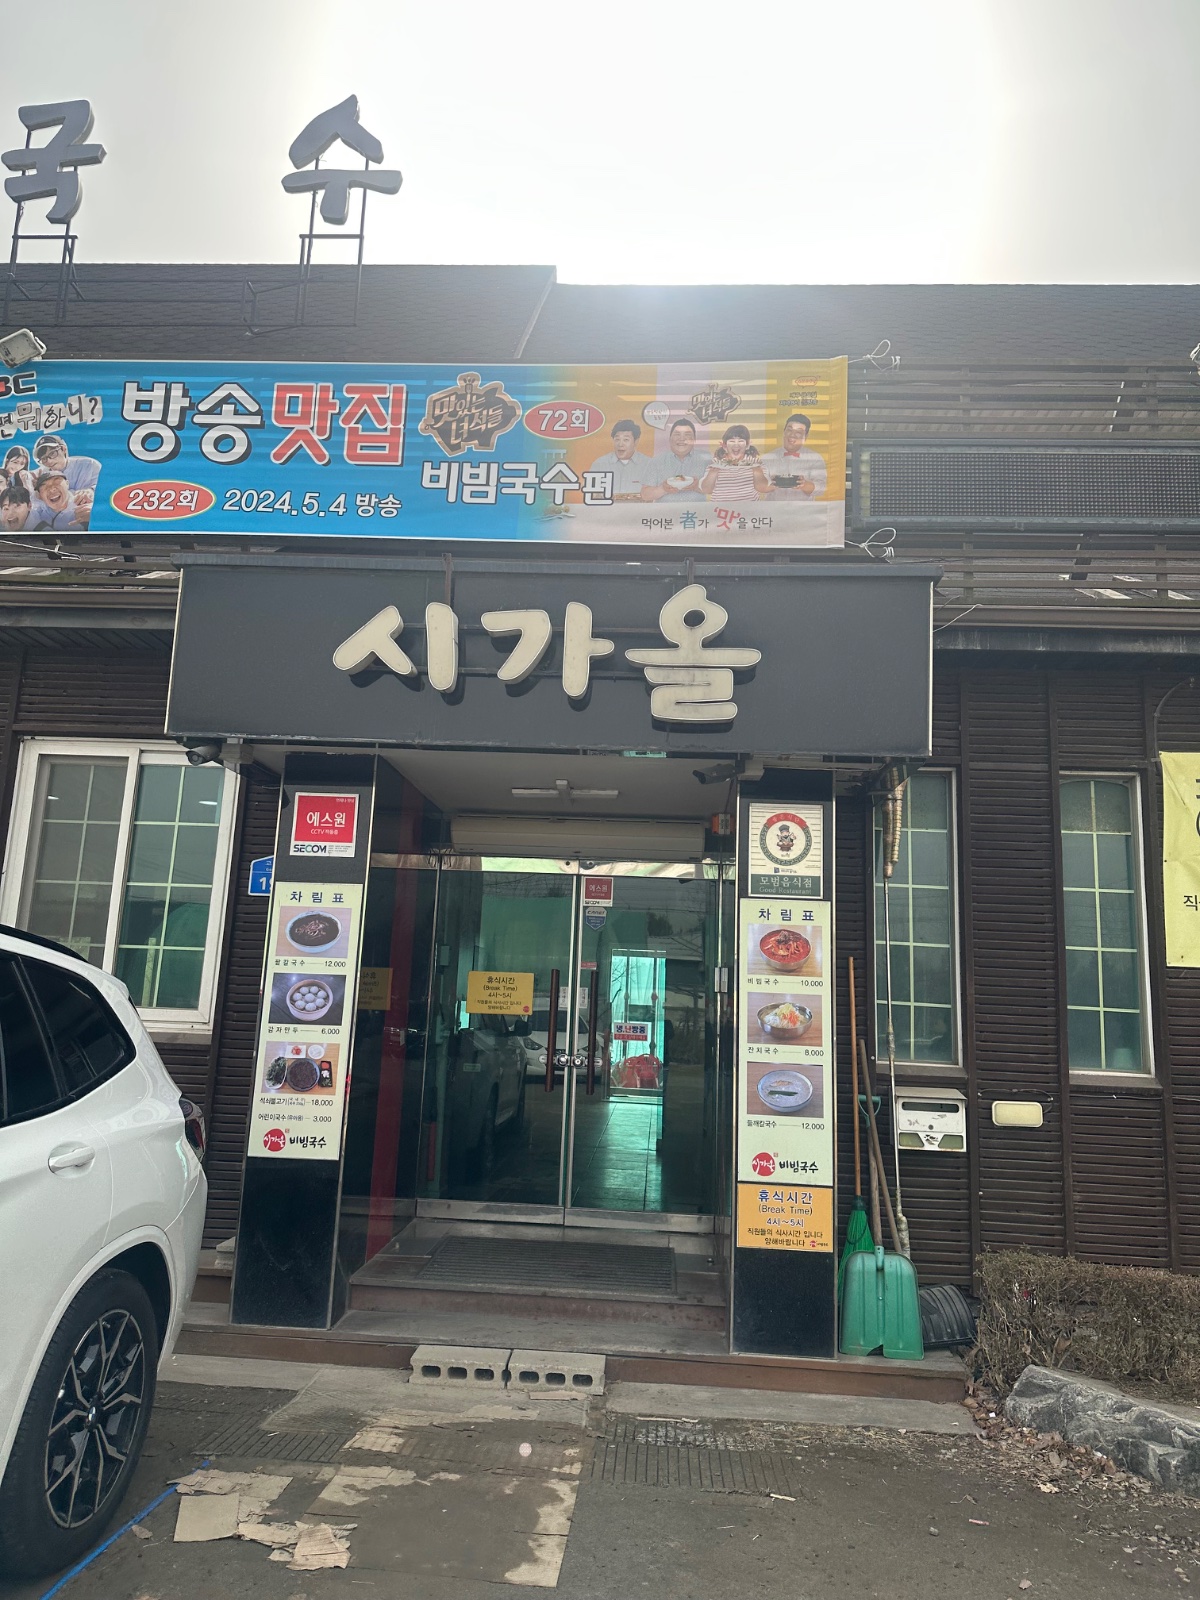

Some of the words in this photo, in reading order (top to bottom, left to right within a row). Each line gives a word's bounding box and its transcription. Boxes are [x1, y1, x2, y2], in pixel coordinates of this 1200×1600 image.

[434, 390, 486, 428] 맛있는
[122, 381, 265, 463] 방송
[271, 382, 408, 465] 맛집
[450, 404, 503, 444] 녀석들
[538, 409, 590, 432] 72회
[126, 489, 199, 512] 232회
[222, 488, 347, 517] 2024.5.4
[355, 493, 402, 518] 방송
[641, 518, 674, 530] 먹어본
[751, 517, 773, 528] 안다
[333, 584, 762, 722] 시가올
[306, 811, 346, 828] 에스원
[293, 844, 327, 853] SECOM
[589, 884, 608, 892] 에스원
[759, 876, 811, 888] 모범음식점
[487, 976, 516, 984] 휴식시간
[747, 1120, 777, 1128] 들깨칼국수
[289, 1136, 326, 1149] 비빔국수
[779, 1160, 818, 1173] 비빔국수
[758, 1189, 813, 1205] 휴식시간
[758, 1204, 785, 1214] (Break
[790, 1206, 813, 1216] Time)
[747, 1228, 773, 1236] 직원들의
[775, 1229, 801, 1238] 식사시간
[803, 1231, 823, 1239] 입니다
[764, 1237, 805, 1247] 양해바랍니다
